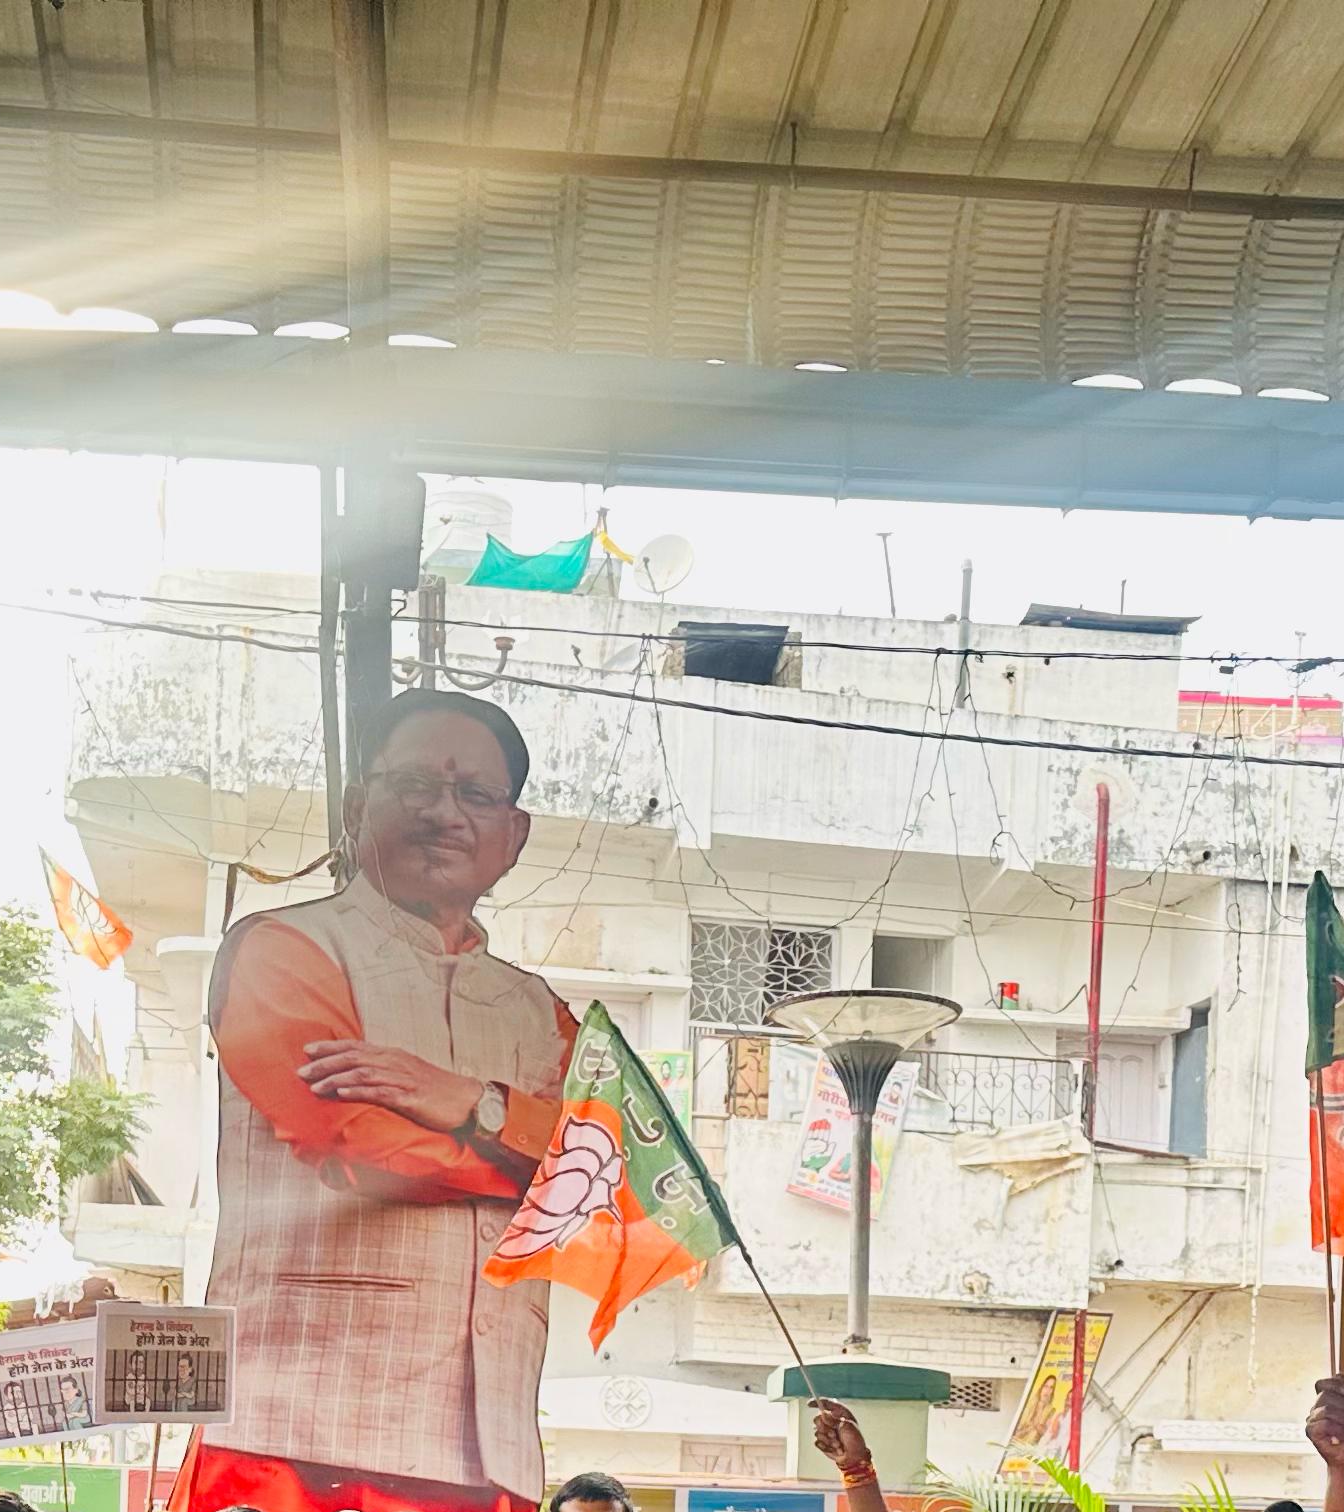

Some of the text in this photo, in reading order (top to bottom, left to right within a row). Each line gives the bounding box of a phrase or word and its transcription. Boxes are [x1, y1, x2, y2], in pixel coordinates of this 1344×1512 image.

[156, 1320, 166, 1332] के
[156, 1334, 176, 1346] जेल
[176, 1334, 187, 1346] के
[189, 1334, 211, 1348] अंदर
[28, 1349, 38, 1360] के
[32, 1361, 53, 1373] जेल
[55, 1359, 68, 1370] के
[70, 1356, 94, 1370] अंदर
